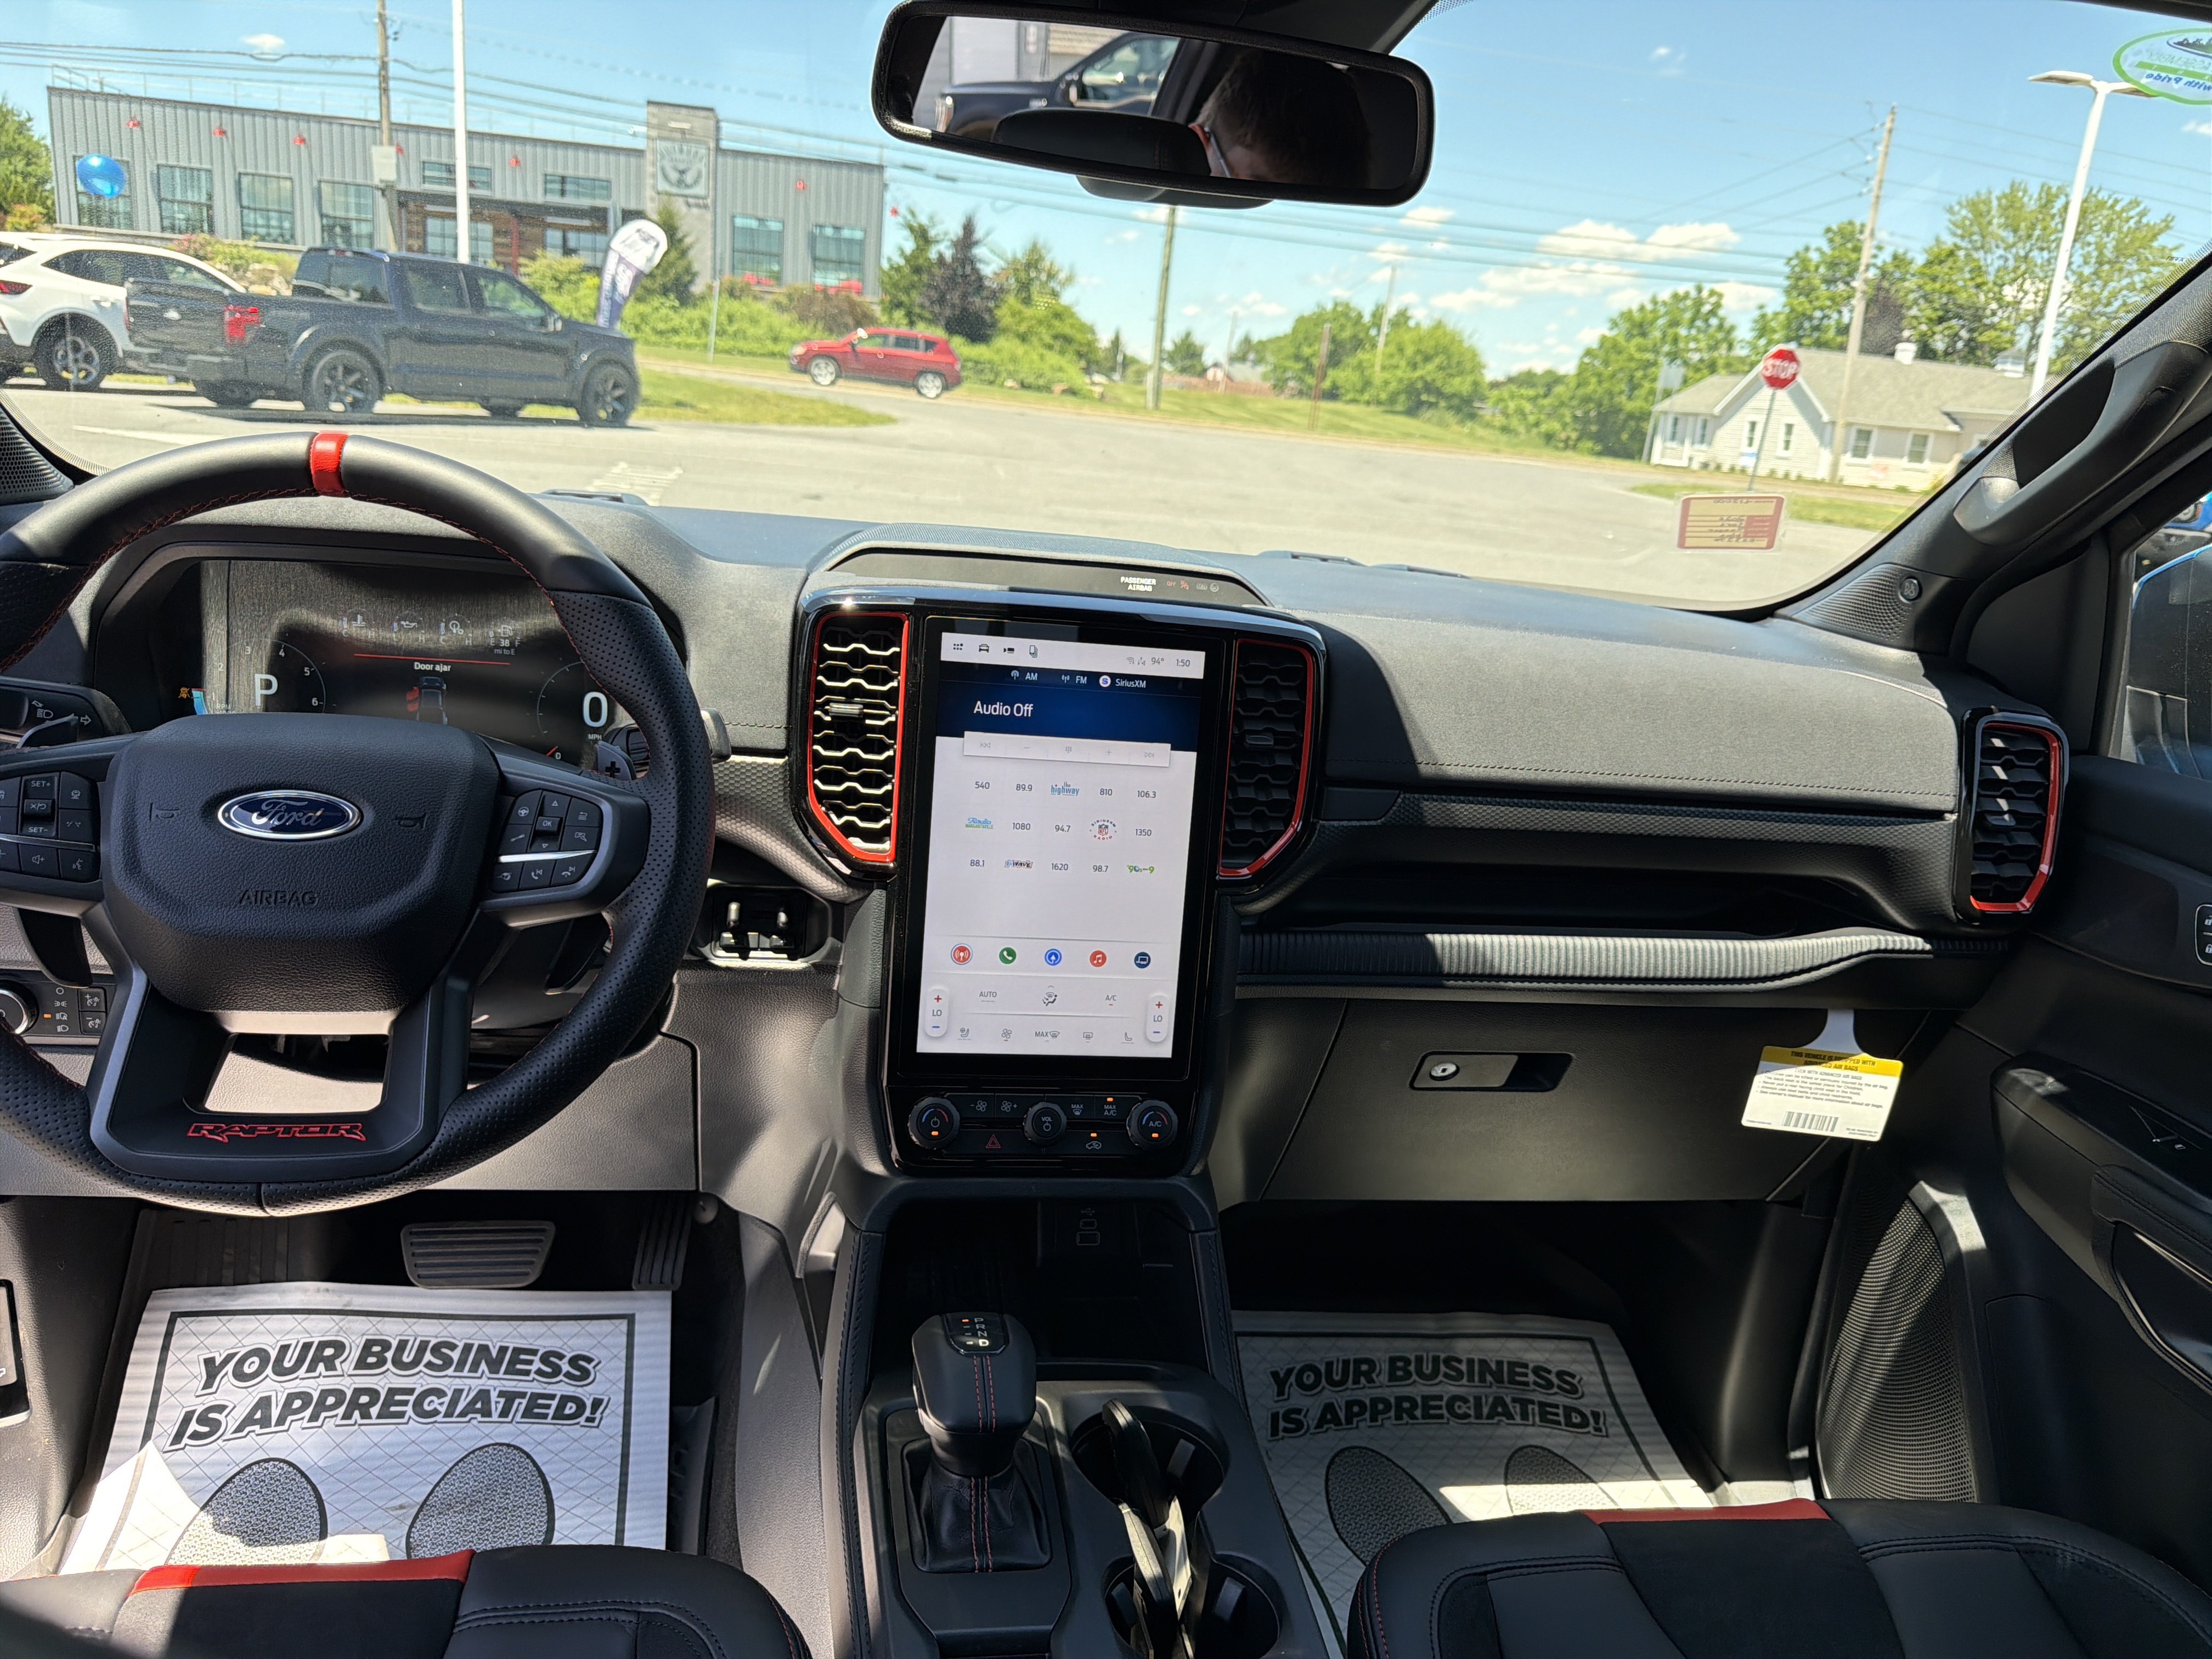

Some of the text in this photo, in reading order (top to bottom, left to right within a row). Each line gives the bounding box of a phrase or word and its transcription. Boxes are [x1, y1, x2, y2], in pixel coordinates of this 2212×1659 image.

[1762, 358, 1799, 379] STOP
[1121, 576, 1156, 585] PASSENGER
[419, 634, 425, 643] H
[245, 646, 251, 654] 3
[279, 648, 285, 657] 4
[1150, 657, 1164, 665] 94°
[1176, 659, 1190, 667] 1:50
[218, 663, 224, 672] 2
[304, 667, 310, 676] 5
[414, 662, 452, 673] Door ajar
[1025, 672, 1038, 681] AM
[1075, 675, 1087, 684] FM
[1115, 679, 1146, 688] SiriusXM
[255, 673, 278, 707] P
[312, 697, 318, 706] 6
[583, 691, 608, 727] 0
[973, 701, 1034, 717] Audio Off
[974, 781, 990, 789] 540
[1015, 783, 1032, 792] 89.9
[1051, 785, 1080, 796] highway
[1137, 790, 1156, 798] 106.3
[251, 799, 324, 826] Ford
[1012, 822, 1031, 831] 1080
[1054, 825, 1071, 833] 94.7
[1135, 828, 1152, 837] 1350
[969, 859, 985, 867] 88.1
[1093, 865, 1109, 873] 98.7
[239, 890, 319, 907] AIRBAG
[1803, 1052, 1826, 1060] VEHICLE
[187, 1123, 366, 1143] RAPTOR
[978, 1339, 989, 1347] D
[199, 1337, 598, 1393] YOUR BUSINESS
[1269, 1353, 1582, 1398] YOUR BUSINESS
[166, 1385, 608, 1448] IS APPRECIATED!
[1268, 1393, 1606, 1438] IS APPRECIATED!
